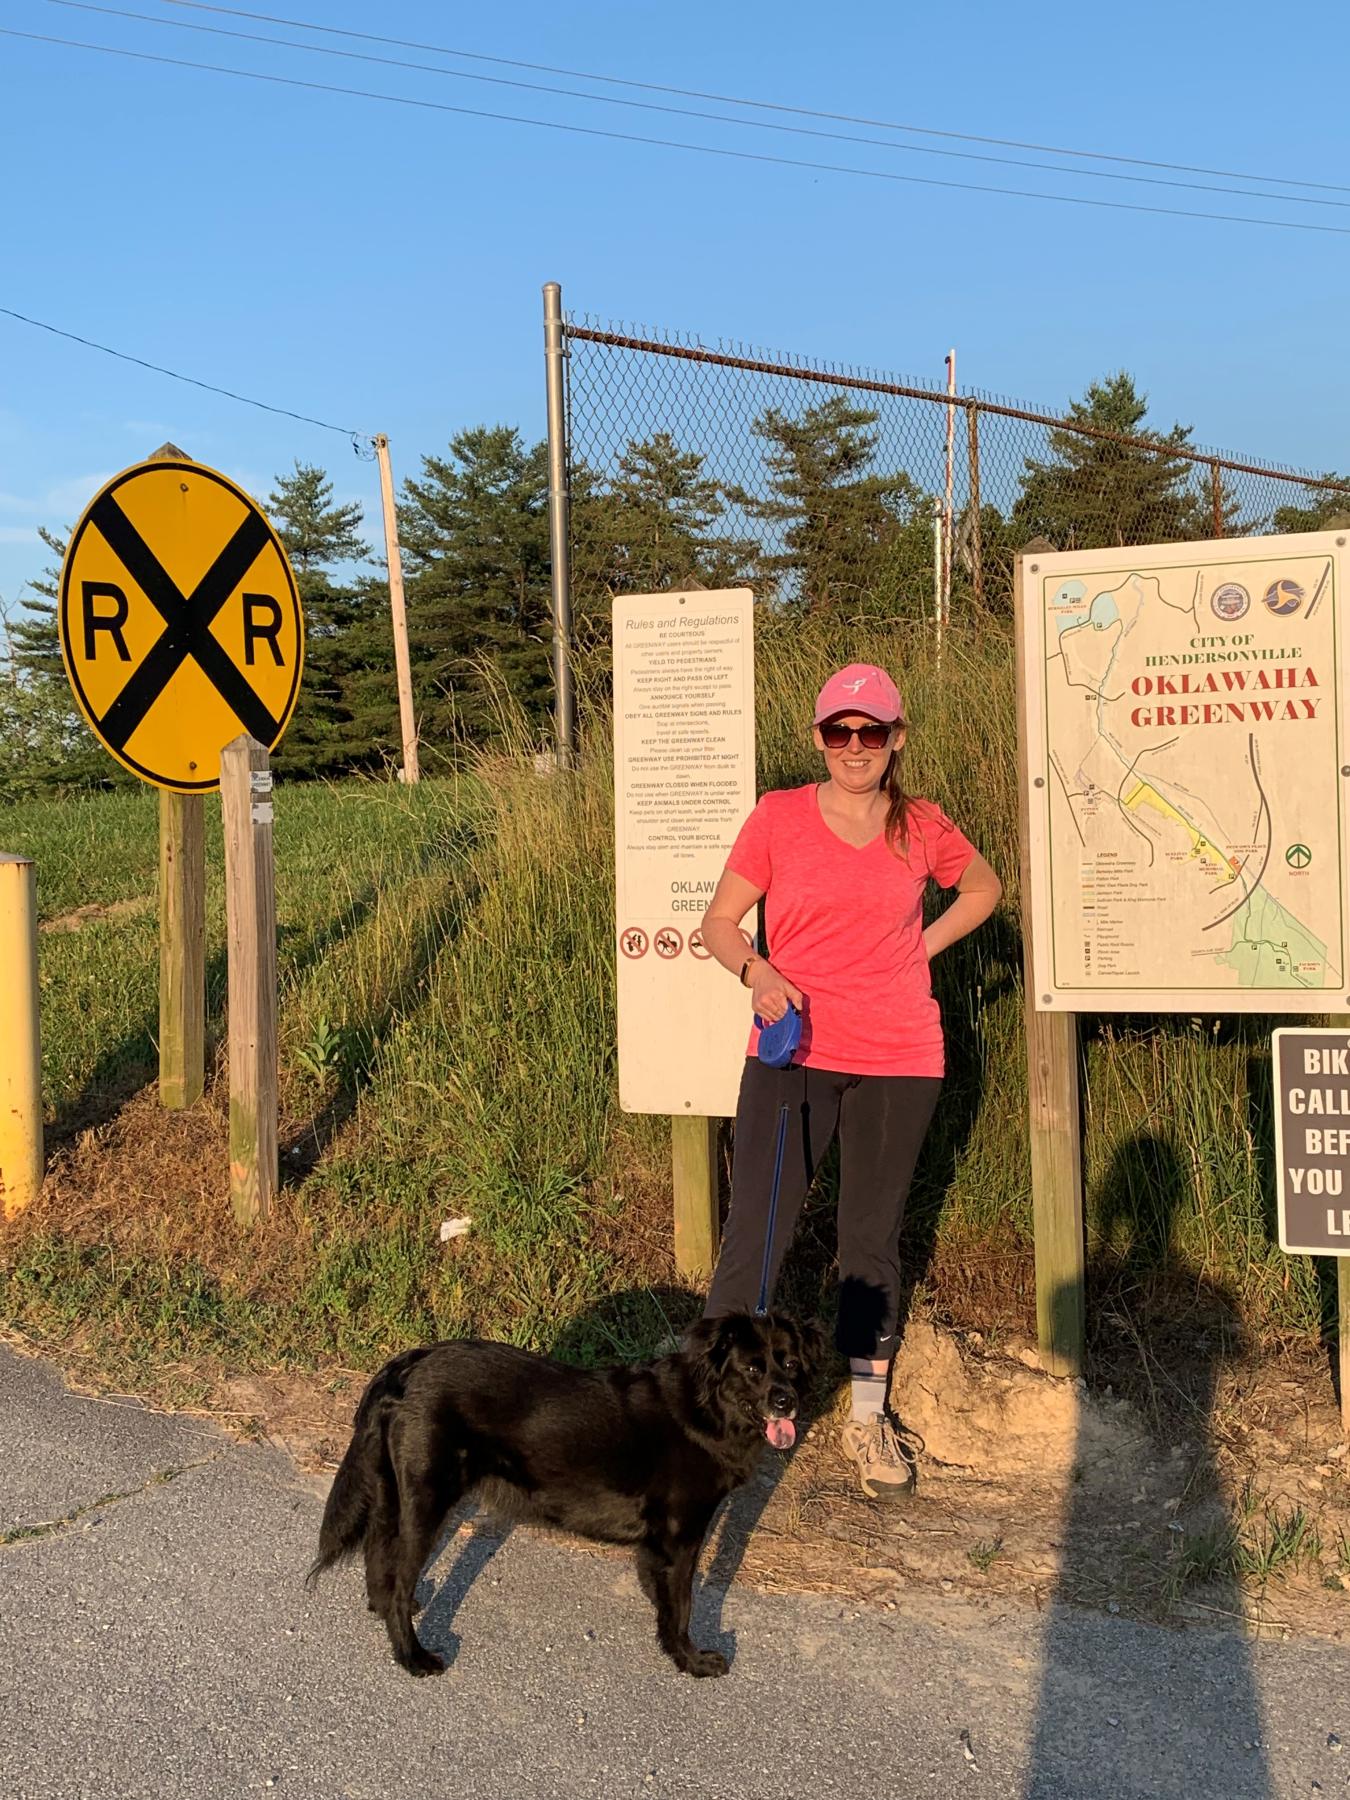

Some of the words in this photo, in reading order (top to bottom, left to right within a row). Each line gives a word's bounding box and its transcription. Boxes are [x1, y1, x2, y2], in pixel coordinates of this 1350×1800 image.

[82, 581, 132, 662] R
[241, 592, 286, 667] R
[626, 619, 654, 629] Rules
[657, 617, 677, 628] and
[679, 616, 739, 628] Regulations
[1190, 636, 1226, 649] CITY
[1232, 634, 1255, 647] OF
[1145, 647, 1302, 667] HENDERSONVILLE
[1131, 667, 1320, 696] OKLAWAHA
[1130, 698, 1322, 728] GREENWAY
[671, 881, 714, 893] OKLAW
[671, 899, 712, 911] GREEN
[1304, 1049, 1349, 1075] BIK
[1305, 1129, 1350, 1155] BEF
[1288, 1168, 1343, 1196] YOU
[1327, 1209, 1350, 1236] LE
